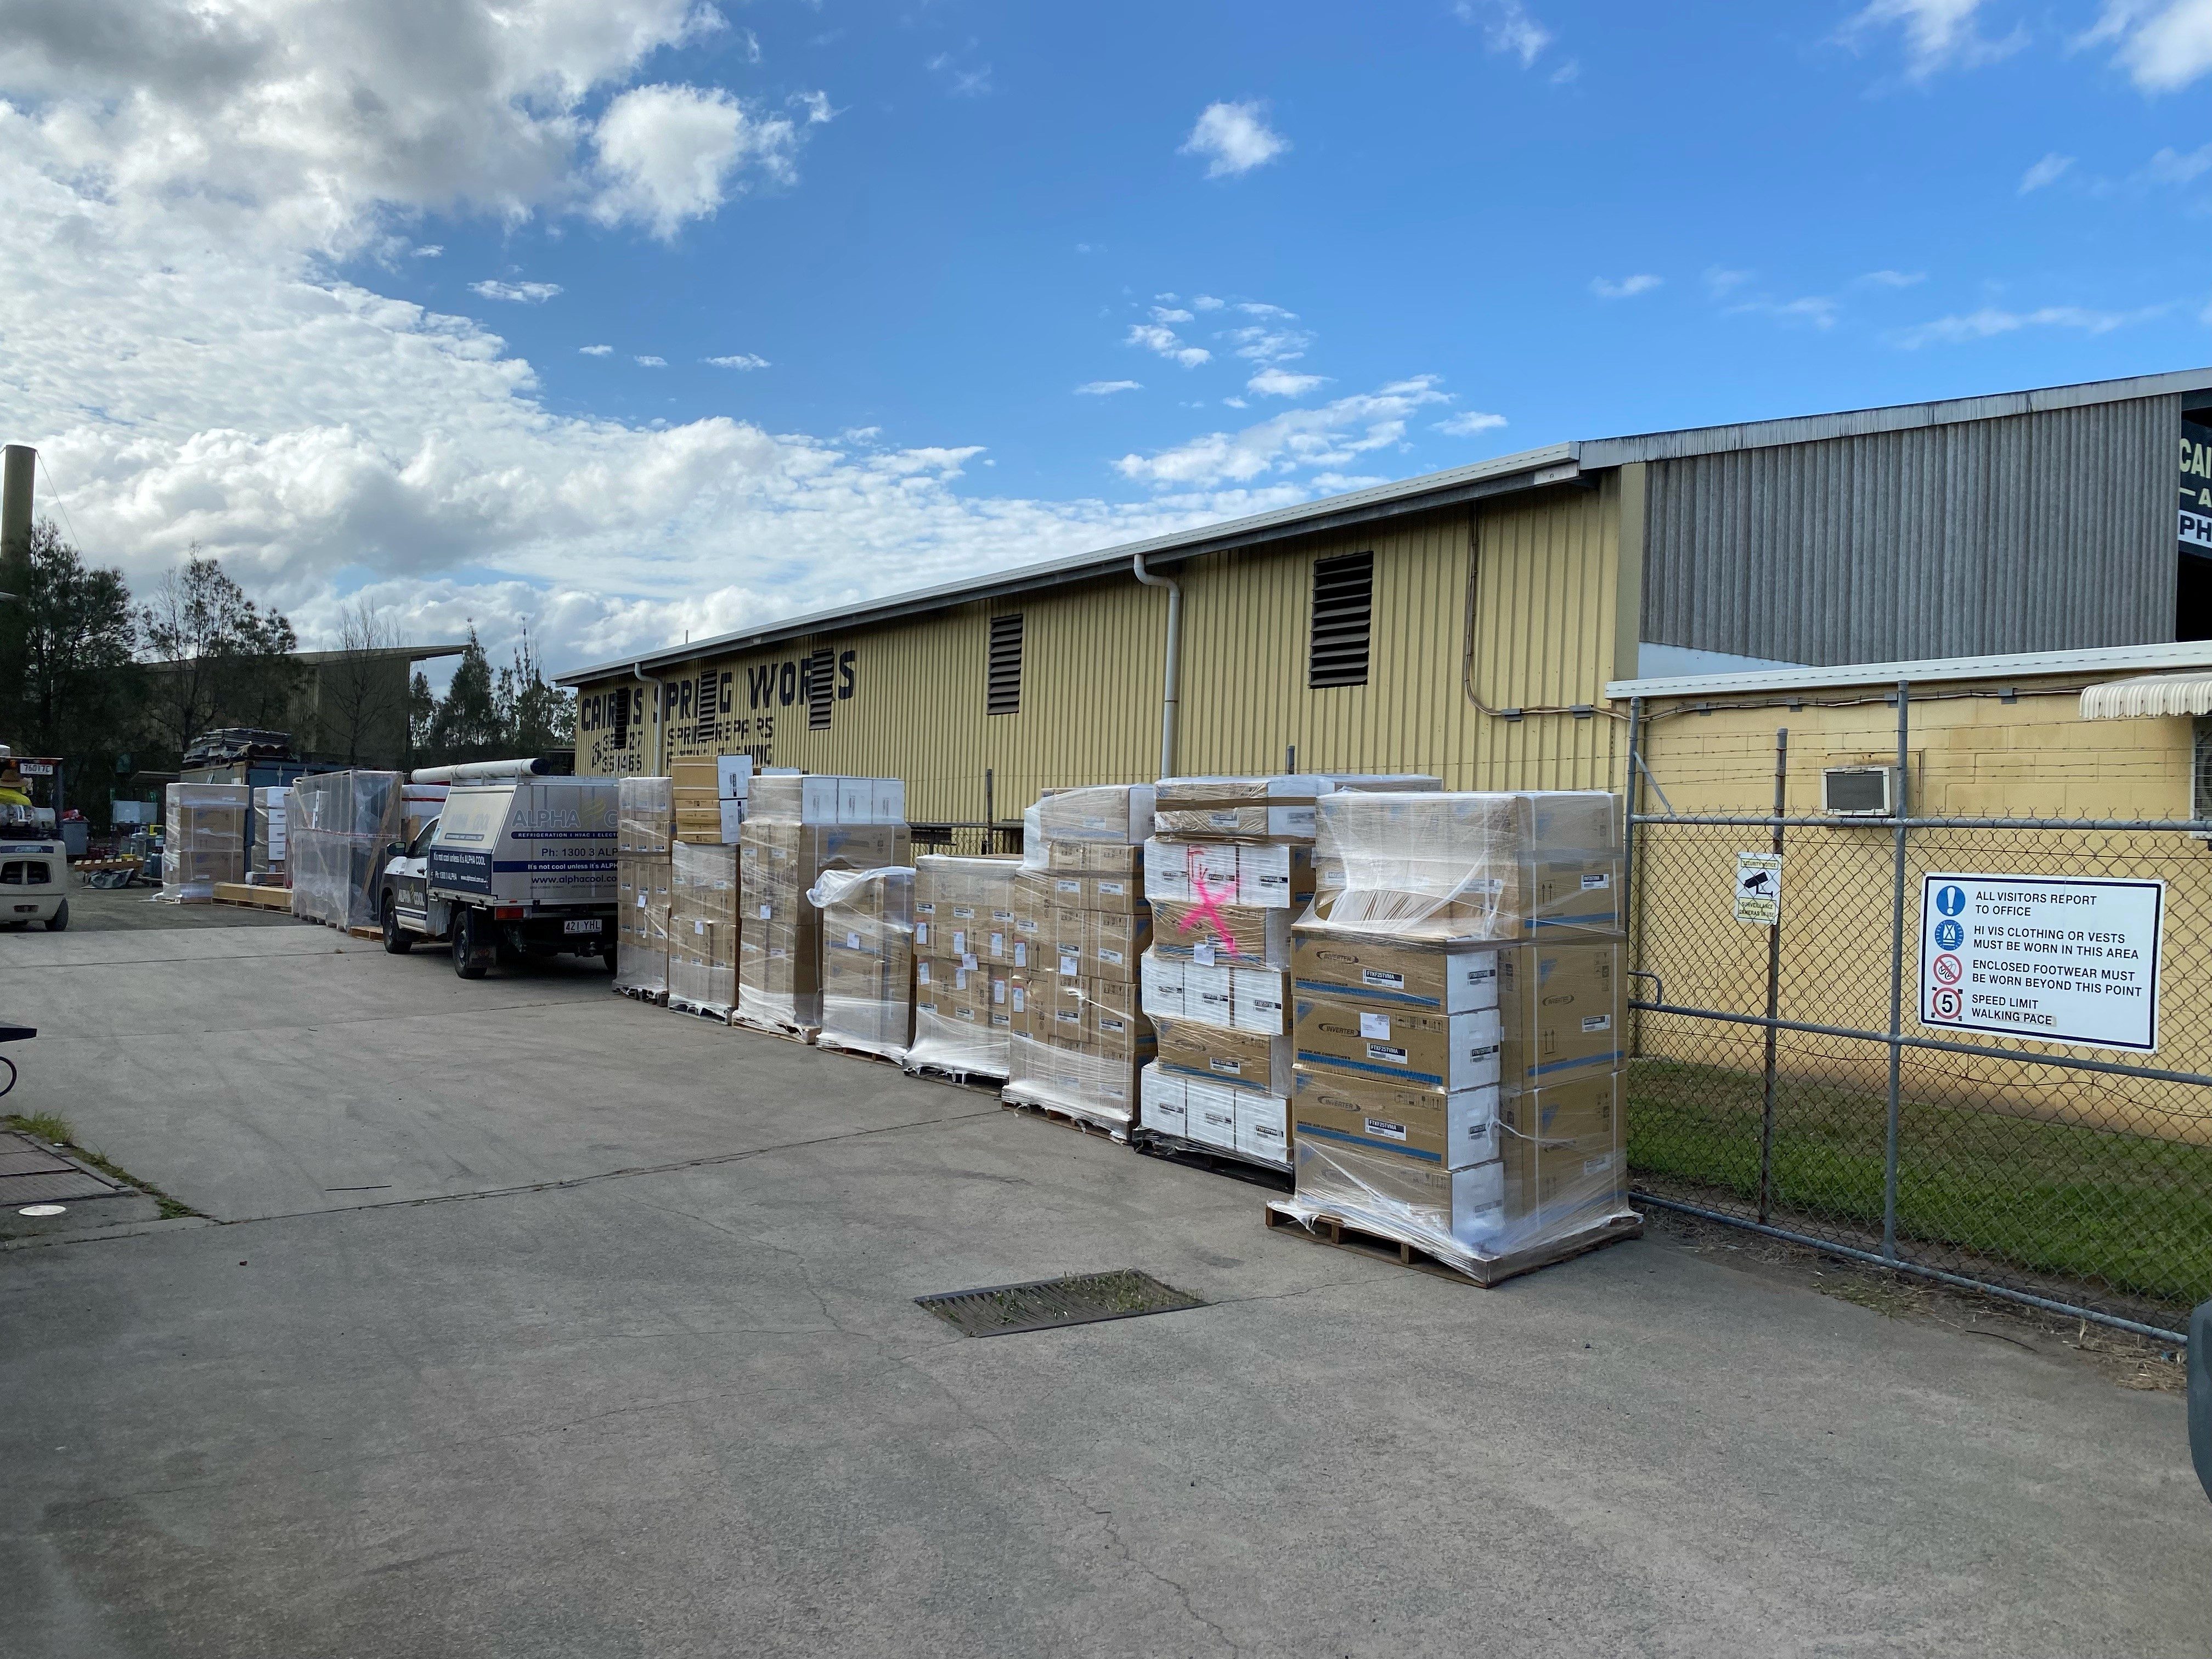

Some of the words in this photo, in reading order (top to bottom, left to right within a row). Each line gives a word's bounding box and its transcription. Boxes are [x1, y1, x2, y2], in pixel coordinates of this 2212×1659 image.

[582, 688, 642, 731] CAIRS
[748, 650, 855, 709] WORS
[511, 809, 581, 828] ALPHA
[541, 848, 558, 856] Ph:
[562, 848, 586, 856] 1300
[589, 848, 595, 856] 3
[1976, 891, 1995, 901] ALL
[1997, 893, 2046, 903] VISITORS
[2050, 894, 2097, 905] REPORT
[1976, 905, 1989, 914] TO
[1993, 906, 2031, 916] OFFICE
[566, 922, 579, 931] 421
[584, 921, 600, 930] YHL
[1974, 926, 1985, 935] HI
[1988, 927, 2004, 936] VIS
[2007, 927, 2063, 940] CLOTHING
[2068, 931, 2084, 941] OR
[2087, 932, 2125, 943] VESTS
[1974, 939, 2004, 950] MUST
[2006, 941, 2021, 951] BE
[2023, 943, 2058, 953] WORN
[2062, 945, 2073, 955] IN
[2078, 946, 2103, 957] THIS
[2106, 948, 2138, 960] AREA
[1324, 953, 1351, 962] INVERTER
[1367, 970, 1395, 980] FTKF25TVMA
[1973, 960, 2030, 973] ENCLOSED
[2034, 964, 2097, 978] FOOTWEAR
[2101, 969, 2135, 981] MUST
[1972, 973, 1985, 983] BE
[1989, 975, 2023, 986] WORN
[2025, 978, 2072, 991] BEYOND
[2075, 981, 2101, 994] THIS
[2106, 985, 2142, 997] POINT
[1942, 995, 1953, 1013] 5
[1972, 994, 2006, 1006] SPEED
[2009, 997, 2039, 1009] LIMIT
[1971, 1008, 2020, 1022] WALKING
[2024, 1013, 2052, 1025] PACE
[1327, 1026, 1355, 1035] INVERTER
[1372, 1045, 1398, 1054] FTKF25TVMA
[1325, 1099, 1353, 1109] INVERTER
[1369, 1119, 1397, 1130] FTKF25TVMA
